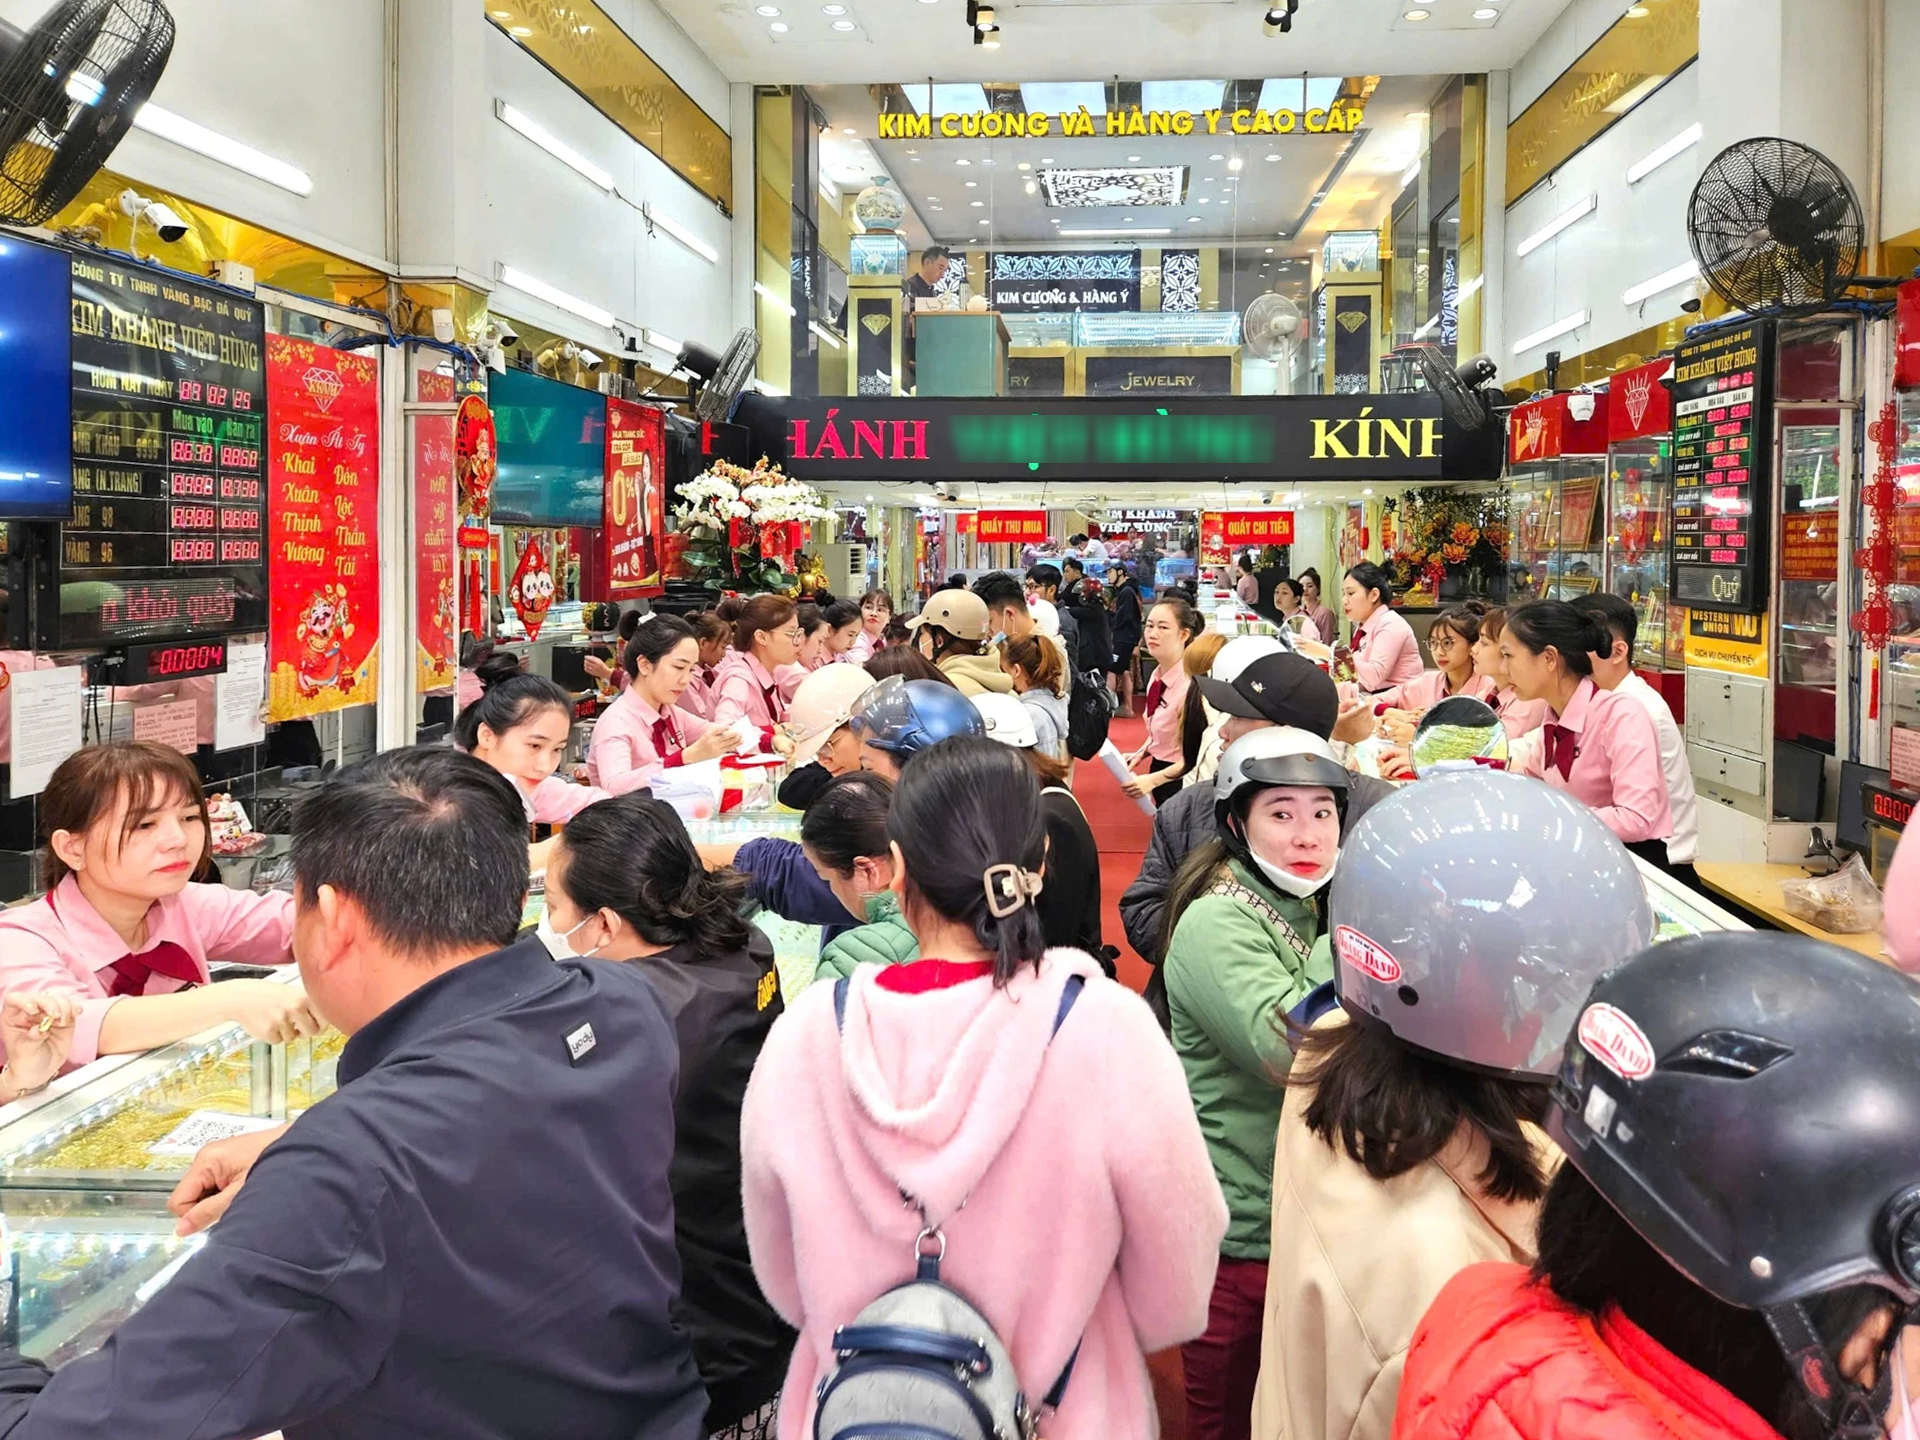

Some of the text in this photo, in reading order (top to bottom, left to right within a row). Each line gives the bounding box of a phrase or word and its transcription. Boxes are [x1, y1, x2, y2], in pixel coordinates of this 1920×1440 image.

[879, 98, 1365, 139] KIM CƯƠNG VÀ HÀNG Y CAO CẤP
[72, 261, 104, 283] CÔNG
[109, 272, 124, 288] TY
[129, 277, 158, 297] TNHH
[162, 284, 190, 306] VÀNG
[194, 296, 212, 314] BẠC
[216, 300, 230, 315] ĐÁ
[997, 288, 1130, 304] KIM CƯƠNG & HÀNG Ý
[111, 306, 177, 354] KHÁNH
[180, 323, 216, 367] VIỆT
[218, 330, 259, 372] HÙNG
[1676, 346, 1757, 384] KIM KHÁNH VIỆT HÙNG
[120, 372, 142, 394] NAY
[1010, 376, 1030, 387] RY
[1120, 372, 1196, 390] JEWELRY
[172, 408, 194, 431] Mua
[196, 412, 214, 434] vào
[280, 424, 318, 445] Xuân
[282, 452, 317, 475] Khai
[334, 464, 358, 486] Đón
[282, 482, 320, 504] Xuân
[68, 501, 90, 528] ÀNG
[102, 506, 114, 528] 98
[334, 494, 354, 521] Lộc
[282, 510, 323, 536] Thịnh
[1004, 520, 1021, 534] THU
[1022, 520, 1042, 534] MUA
[1252, 520, 1268, 534] CHI
[66, 536, 90, 563] VÀNG
[101, 542, 113, 563] 96
[282, 540, 326, 568] Vượng
[1692, 610, 1730, 623] WESTERN
[1702, 614, 1758, 638] UNION WU
[572, 1032, 593, 1054] yody
